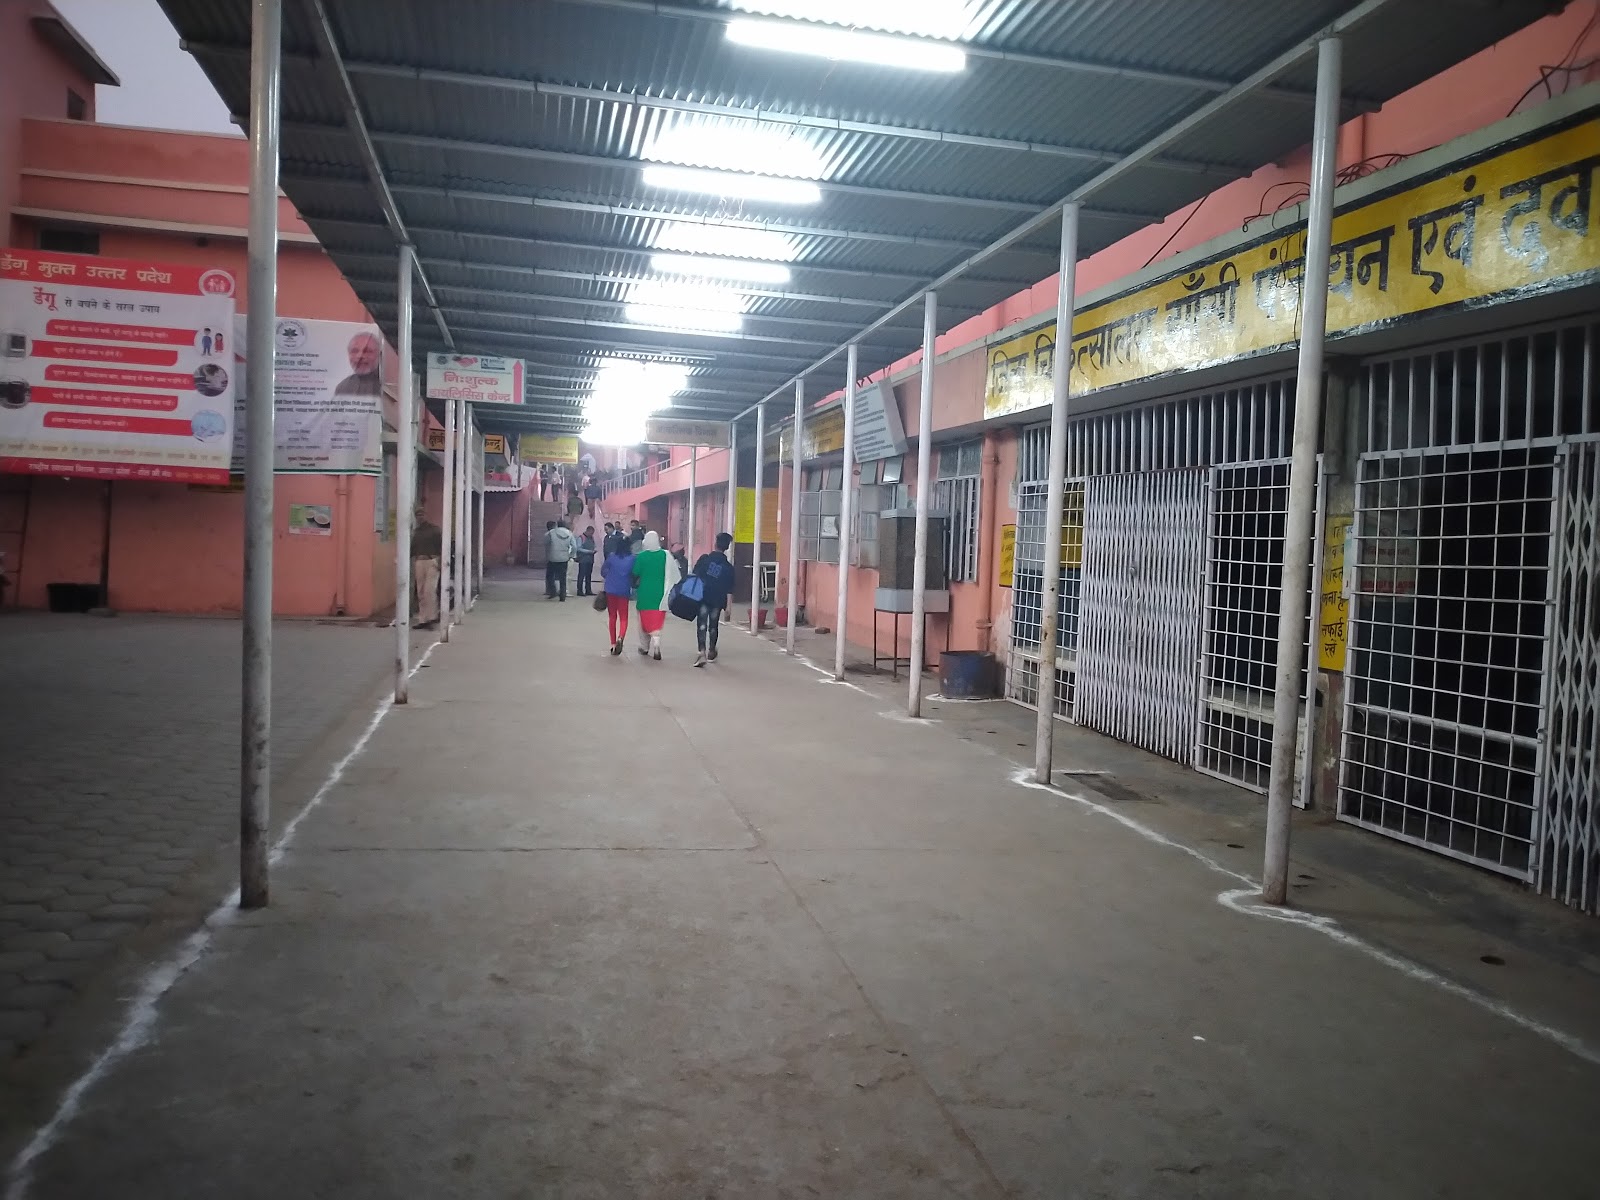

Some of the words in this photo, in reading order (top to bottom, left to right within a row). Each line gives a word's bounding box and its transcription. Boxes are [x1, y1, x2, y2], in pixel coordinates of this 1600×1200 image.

[1408, 174, 1484, 295] एवं
[1500, 153, 1600, 273] दव
[38, 261, 76, 278] मुक्त
[86, 265, 126, 281] उत्तर
[136, 267, 172, 284] प्रदेश
[33, 287, 58, 311] डेंगू
[64, 298, 72, 308] से
[77, 299, 97, 309] बचने
[103, 299, 111, 310] के
[116, 303, 134, 313] सरल
[139, 304, 160, 314] उपाय
[443, 371, 498, 389] निःशुल्क
[430, 387, 484, 401] डायलिसिस
[488, 390, 511, 402] केन्द्र
